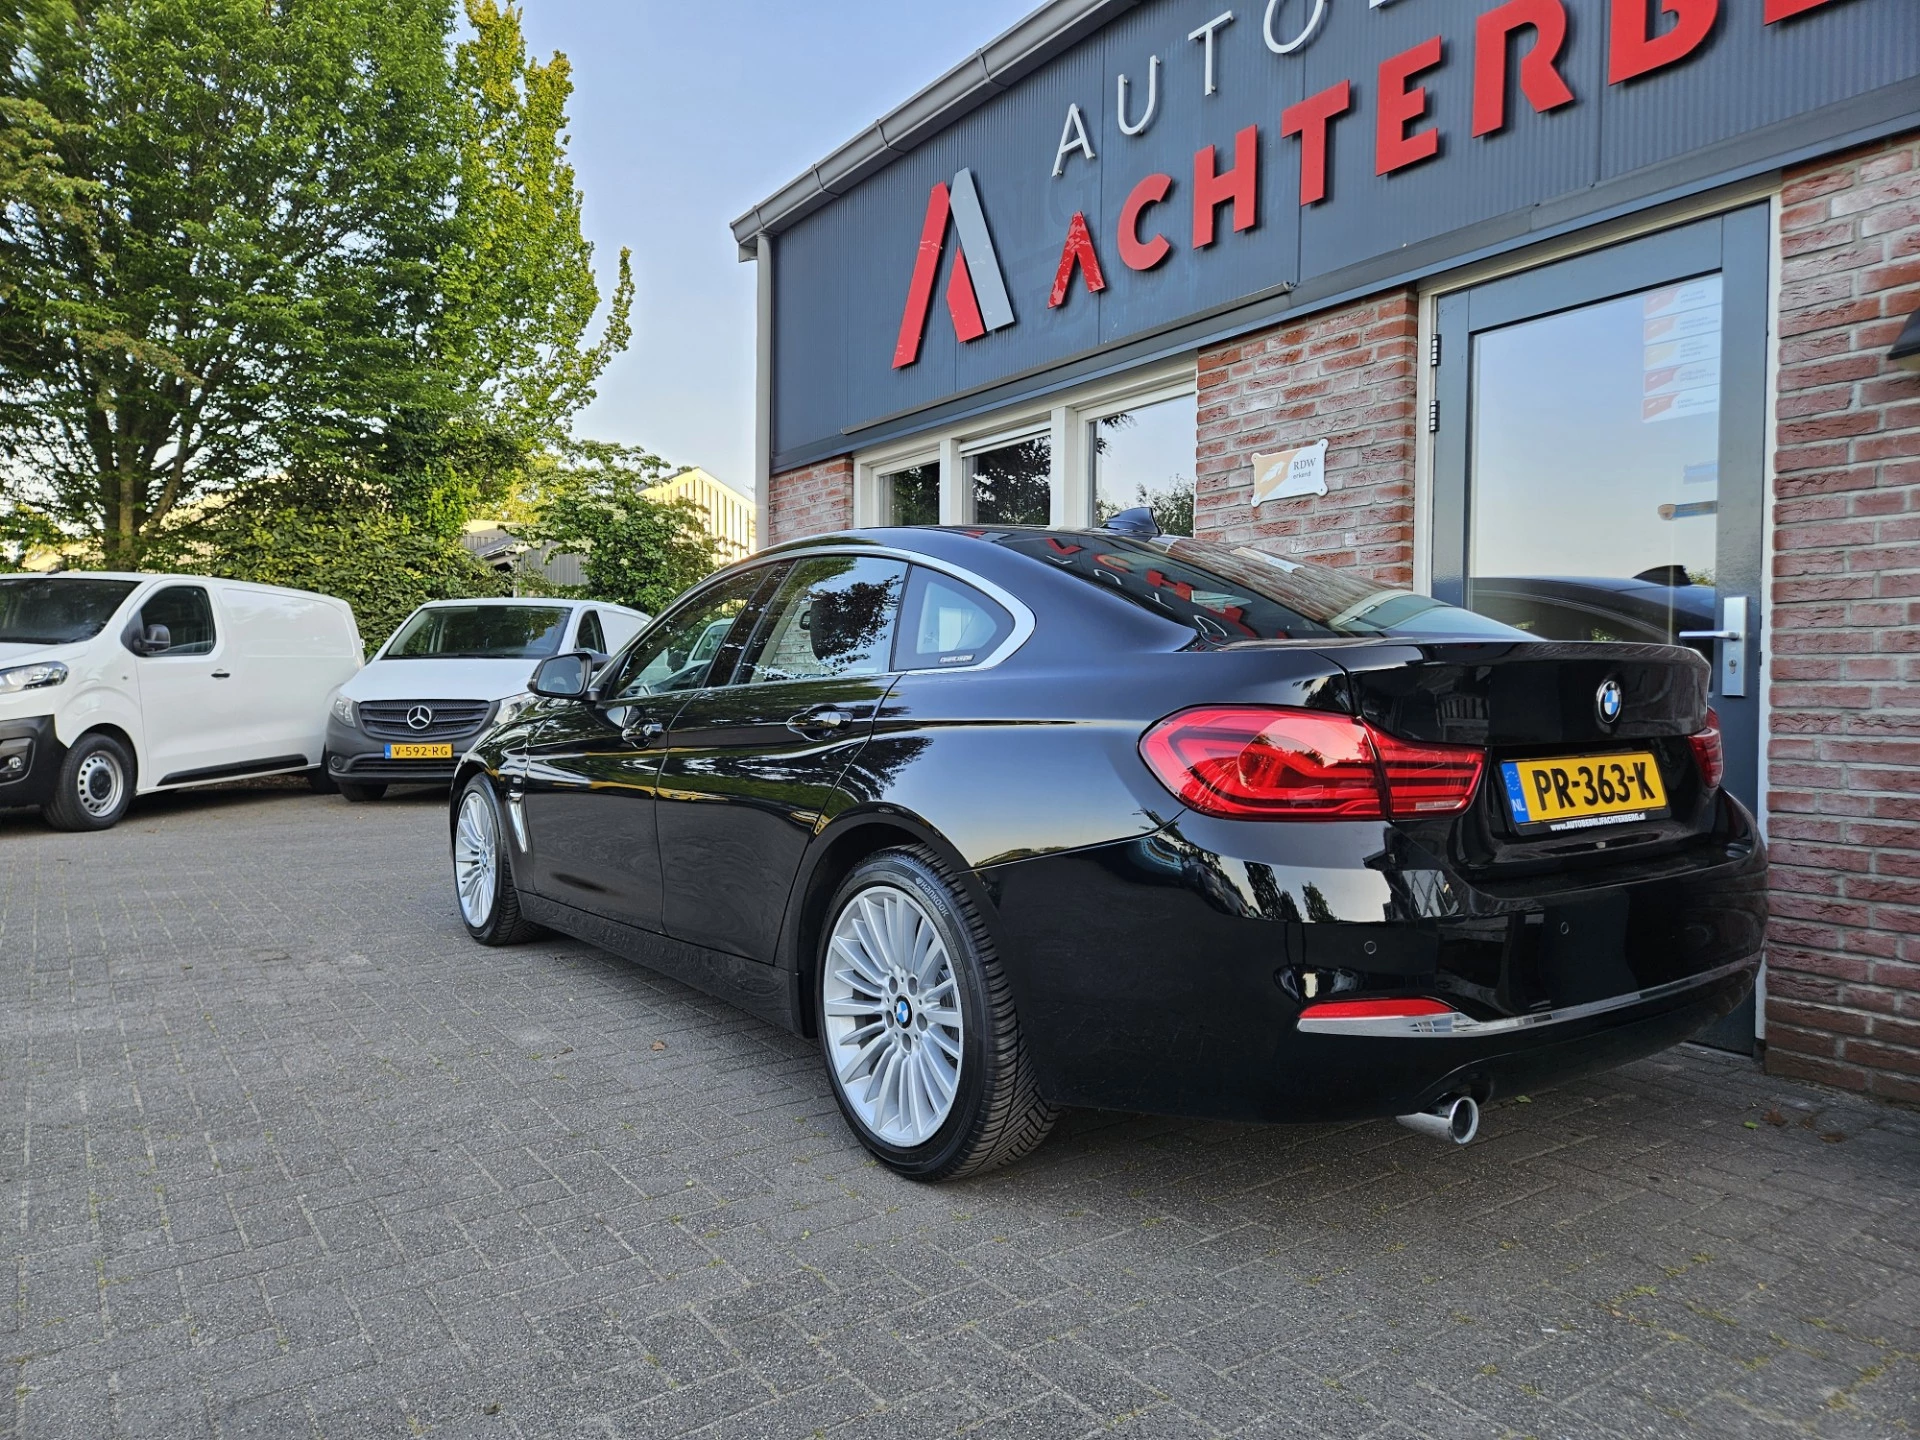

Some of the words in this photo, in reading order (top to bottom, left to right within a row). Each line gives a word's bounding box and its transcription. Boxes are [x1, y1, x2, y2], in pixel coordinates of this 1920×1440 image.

[1052, 0, 1394, 177] AUTO
[1047, 0, 1831, 309] ACHTERB
[1293, 458, 1316, 471] RDW
[394, 746, 448, 756] V-592-RG
[1532, 761, 1656, 811] PR-363-K
[1511, 798, 1526, 812] NL
